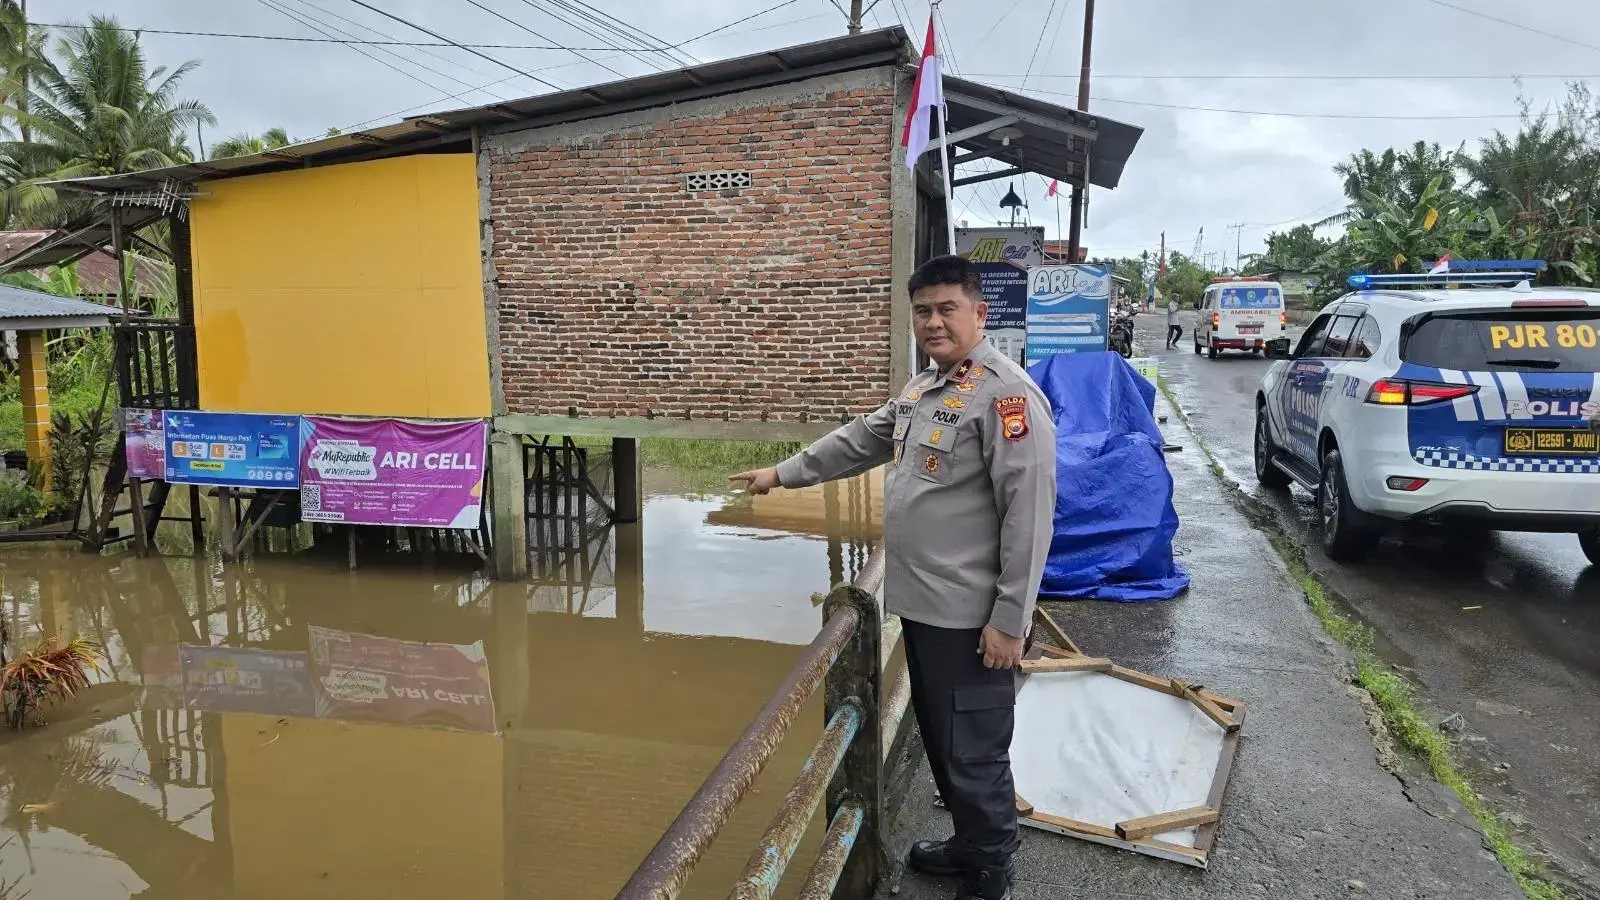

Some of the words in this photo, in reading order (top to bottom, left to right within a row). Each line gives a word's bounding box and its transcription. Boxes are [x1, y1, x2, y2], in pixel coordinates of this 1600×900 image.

[968, 237, 1007, 263] ARI
[1002, 245, 1030, 260] Cell
[1033, 269, 1077, 294] ARI
[1490, 324, 1549, 349] PJR
[1555, 324, 1600, 348] 80
[1342, 376, 1360, 399] PJR
[996, 397, 1024, 409] POLDA
[1291, 385, 1318, 421] POLISI
[1506, 400, 1600, 416] POLIS
[931, 409, 960, 425] POLRI
[1537, 433, 1565, 448] 122591
[1572, 433, 1595, 448] XXVII
[322, 450, 371, 464] MyRepublic
[379, 451, 417, 469] ARI
[423, 452, 477, 470] CELL
